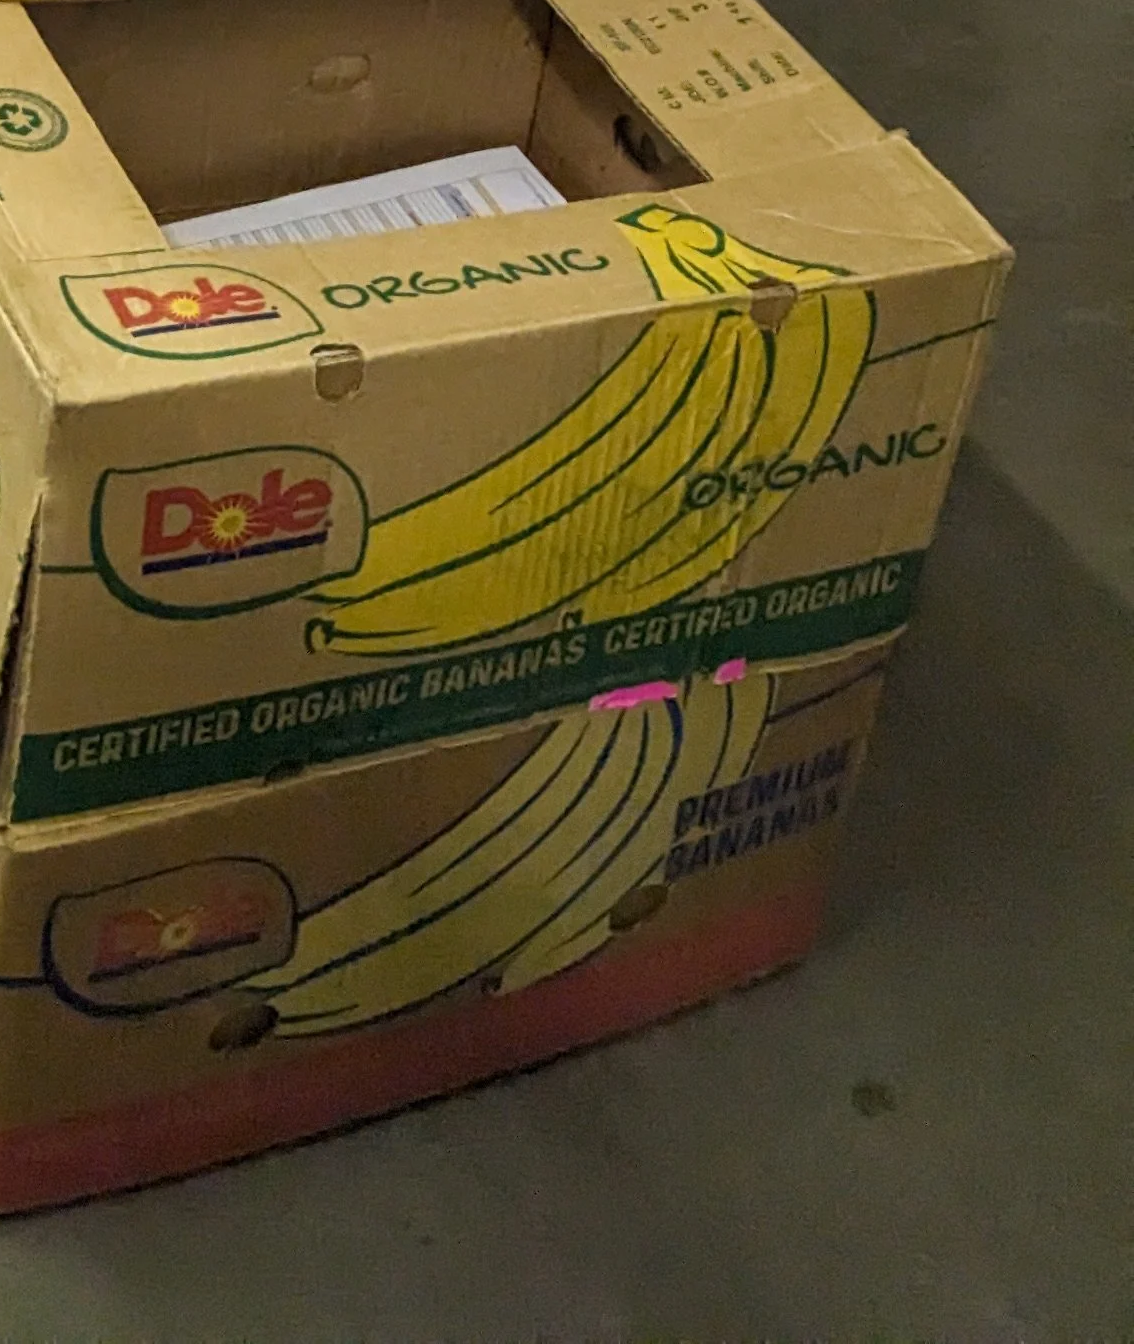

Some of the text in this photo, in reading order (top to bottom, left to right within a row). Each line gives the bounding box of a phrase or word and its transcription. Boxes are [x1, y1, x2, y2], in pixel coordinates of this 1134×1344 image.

[103, 276, 265, 329] Dole
[320, 248, 610, 309] ORGANIC
[681, 422, 947, 510] ORGANIC
[140, 468, 333, 557] Dole
[52, 561, 902, 773] CERTIFIED ORGANIC BANANAS CERTIFIED ORGANIC
[673, 738, 855, 840] PREMIUM
